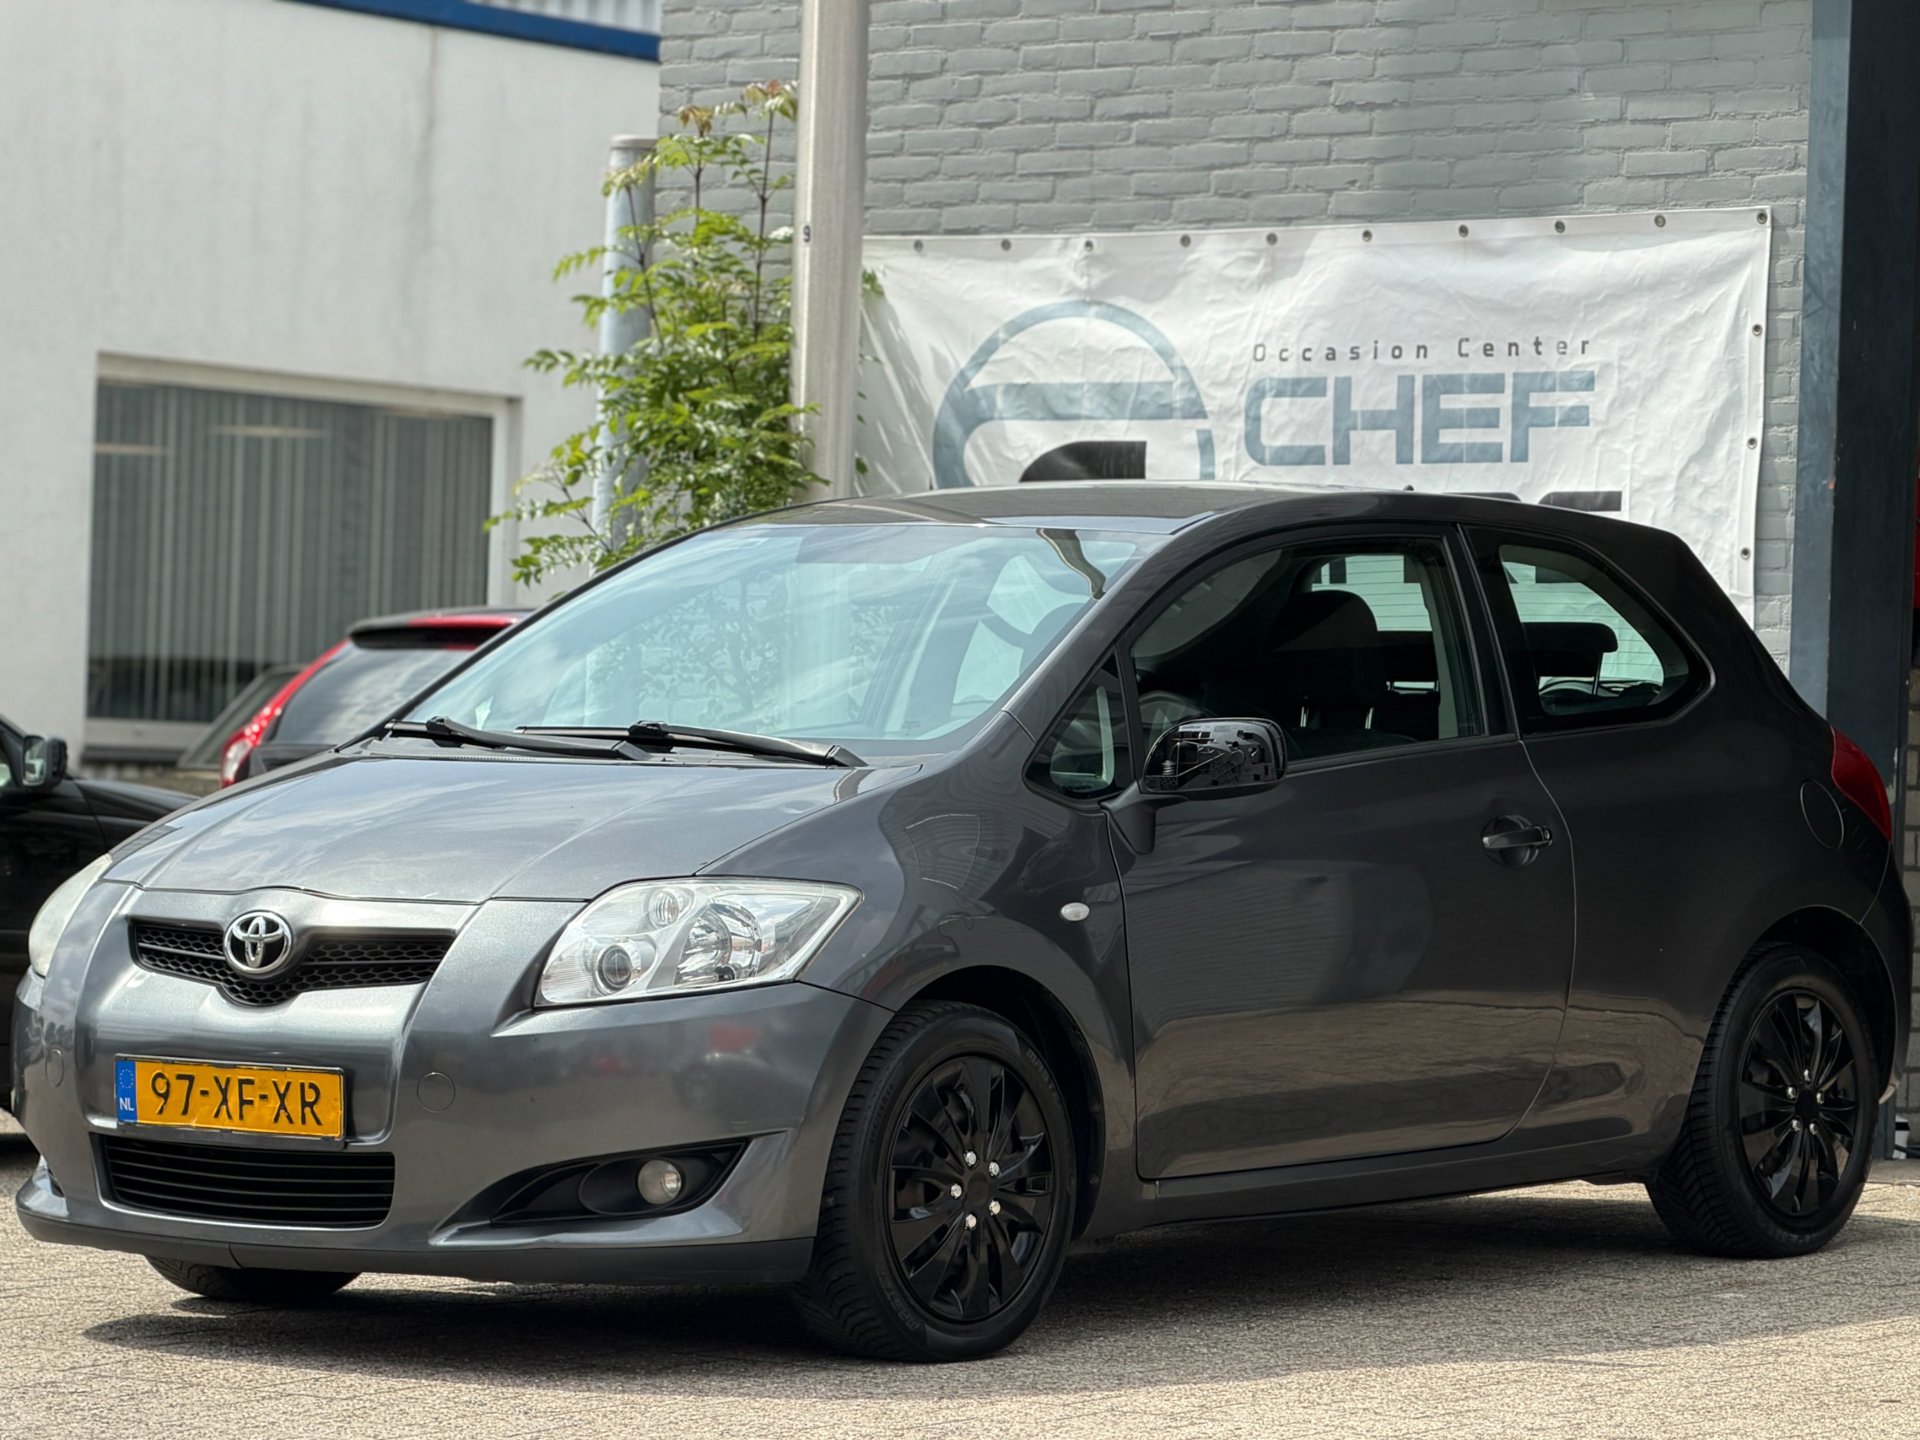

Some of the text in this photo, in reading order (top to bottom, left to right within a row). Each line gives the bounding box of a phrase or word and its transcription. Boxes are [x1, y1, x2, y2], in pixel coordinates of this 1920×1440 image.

[1253, 335, 1590, 362] Occasion Center
[1244, 370, 1596, 466] CHEF
[119, 1097, 135, 1111] NL
[151, 1071, 323, 1126] 97-XF-XR
